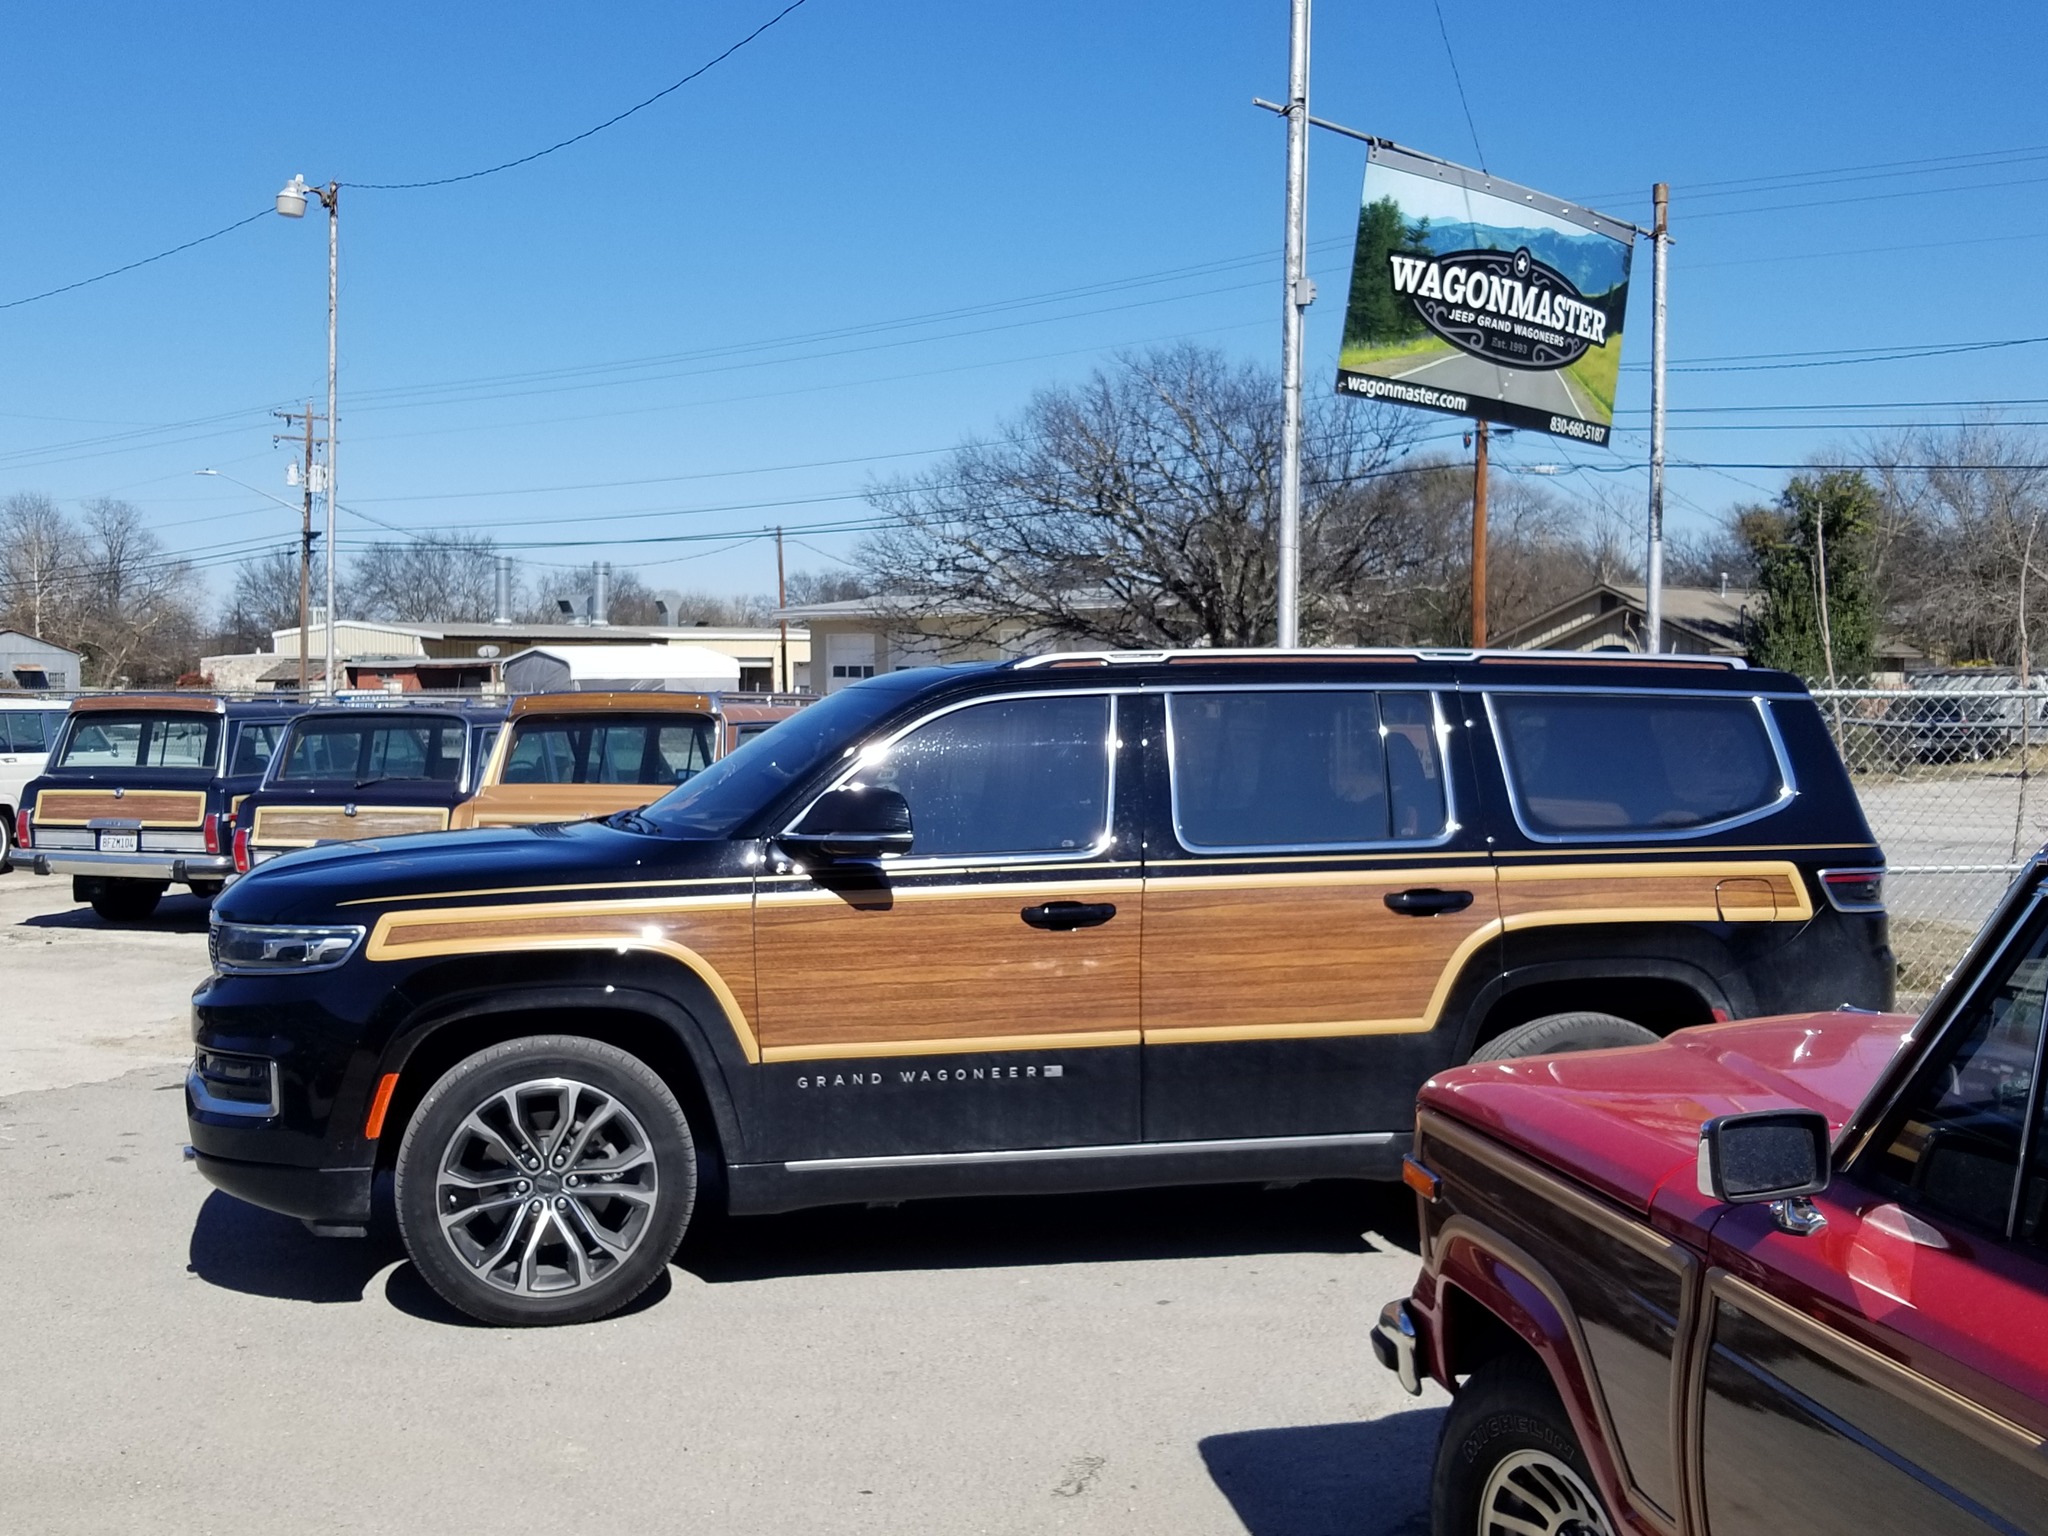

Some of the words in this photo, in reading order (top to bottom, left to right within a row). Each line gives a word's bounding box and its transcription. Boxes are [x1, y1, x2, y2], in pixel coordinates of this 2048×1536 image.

[1390, 256, 1606, 343] WAGONMASTER
[1448, 308, 1475, 324] JEEP
[1477, 315, 1512, 333] GRAND
[1513, 323, 1565, 347] WAGONEERS
[1490, 336, 1508, 349] Est.
[1509, 341, 1528, 354] 1993
[1347, 376, 1467, 411] wagonmaster.com
[1549, 416, 1605, 443] 830-660-5187
[797, 1072, 882, 1089] GRAND
[900, 1066, 1038, 1083] WAGONEER
[1462, 1414, 1575, 1464] MICHELIN
